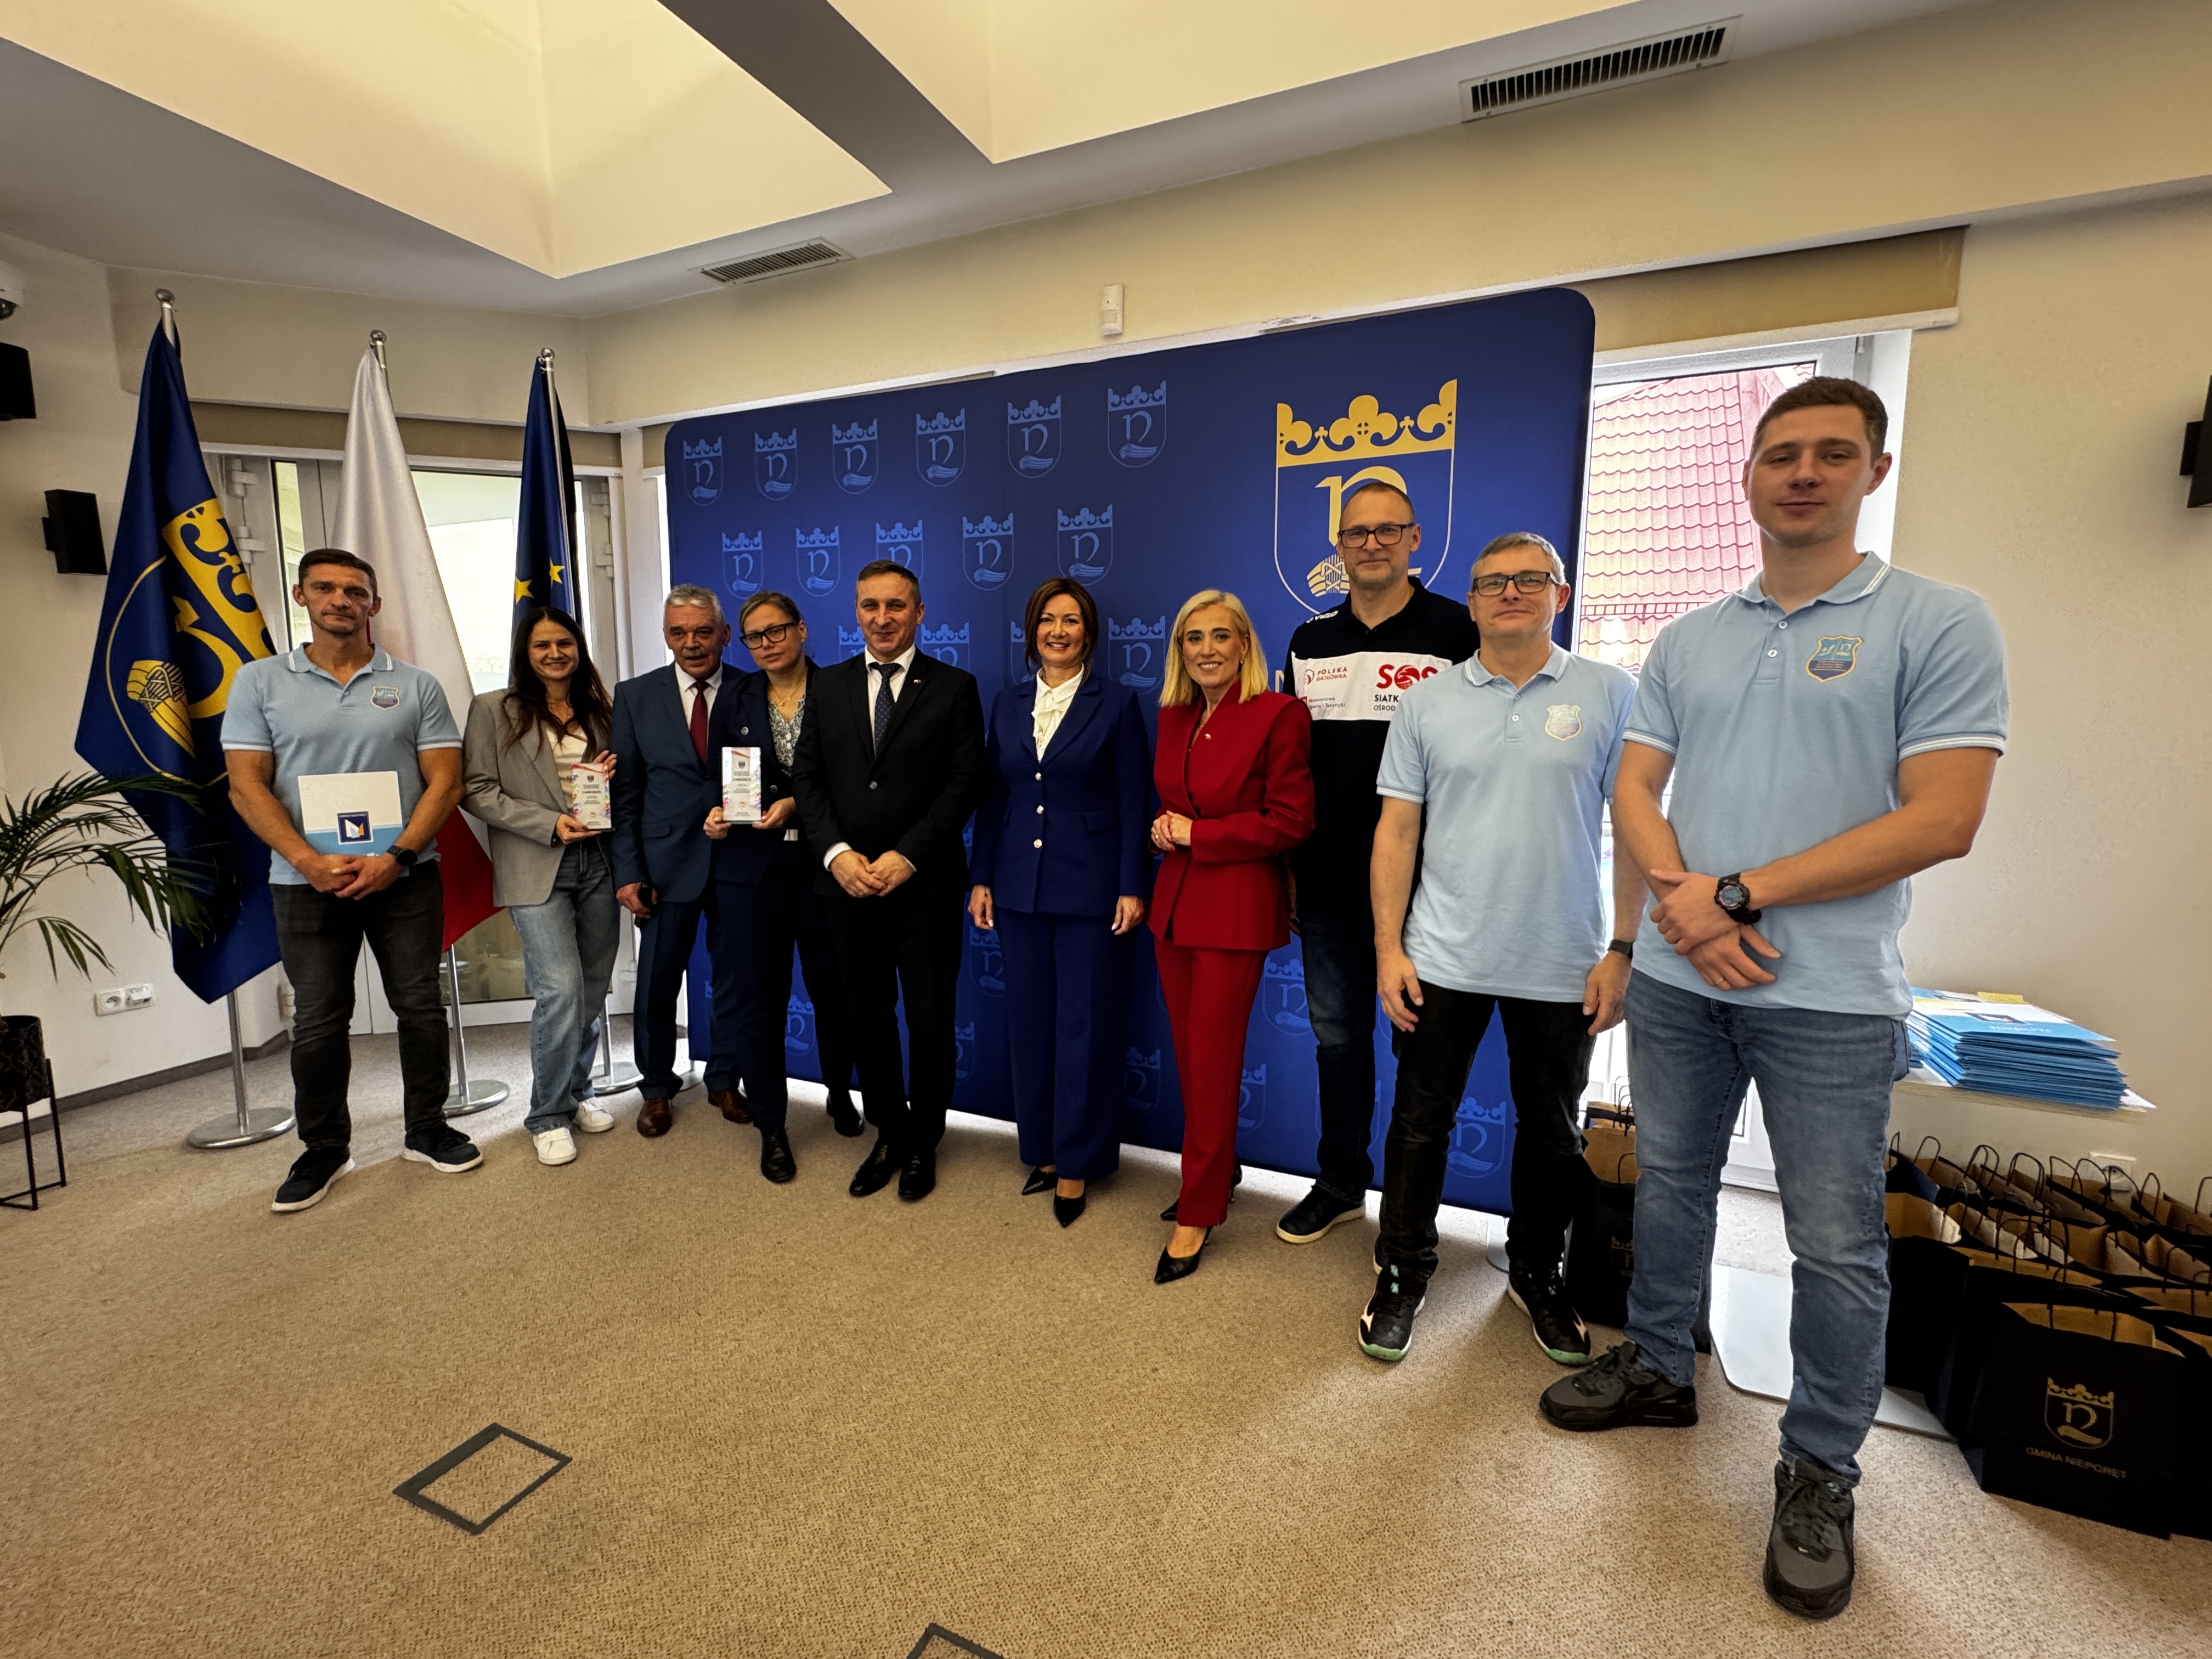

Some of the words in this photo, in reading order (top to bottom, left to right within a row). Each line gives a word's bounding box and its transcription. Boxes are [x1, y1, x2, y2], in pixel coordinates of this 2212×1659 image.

[1317, 667, 1347, 675] POLSKA
[1374, 694, 1400, 703] SIATK
[2025, 1447, 2064, 1462] GMINA
